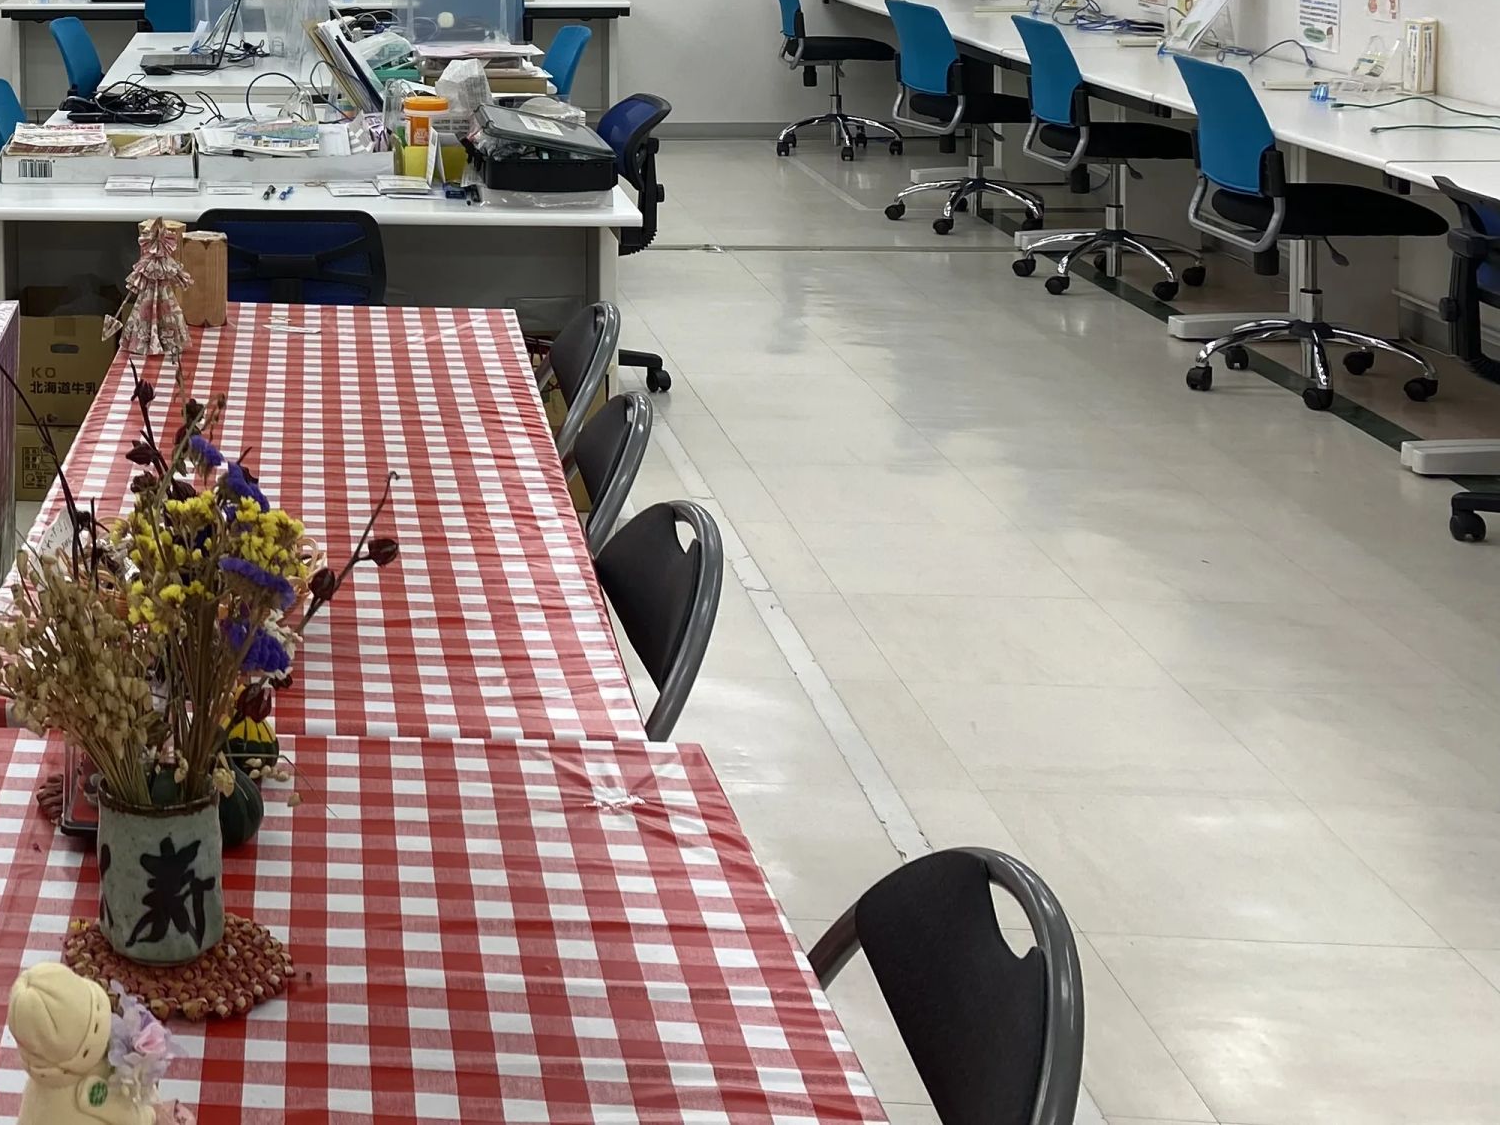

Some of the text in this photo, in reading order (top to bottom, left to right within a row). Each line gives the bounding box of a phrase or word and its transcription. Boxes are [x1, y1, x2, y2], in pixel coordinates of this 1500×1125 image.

[30, 381, 97, 395] 北海道牛乳
